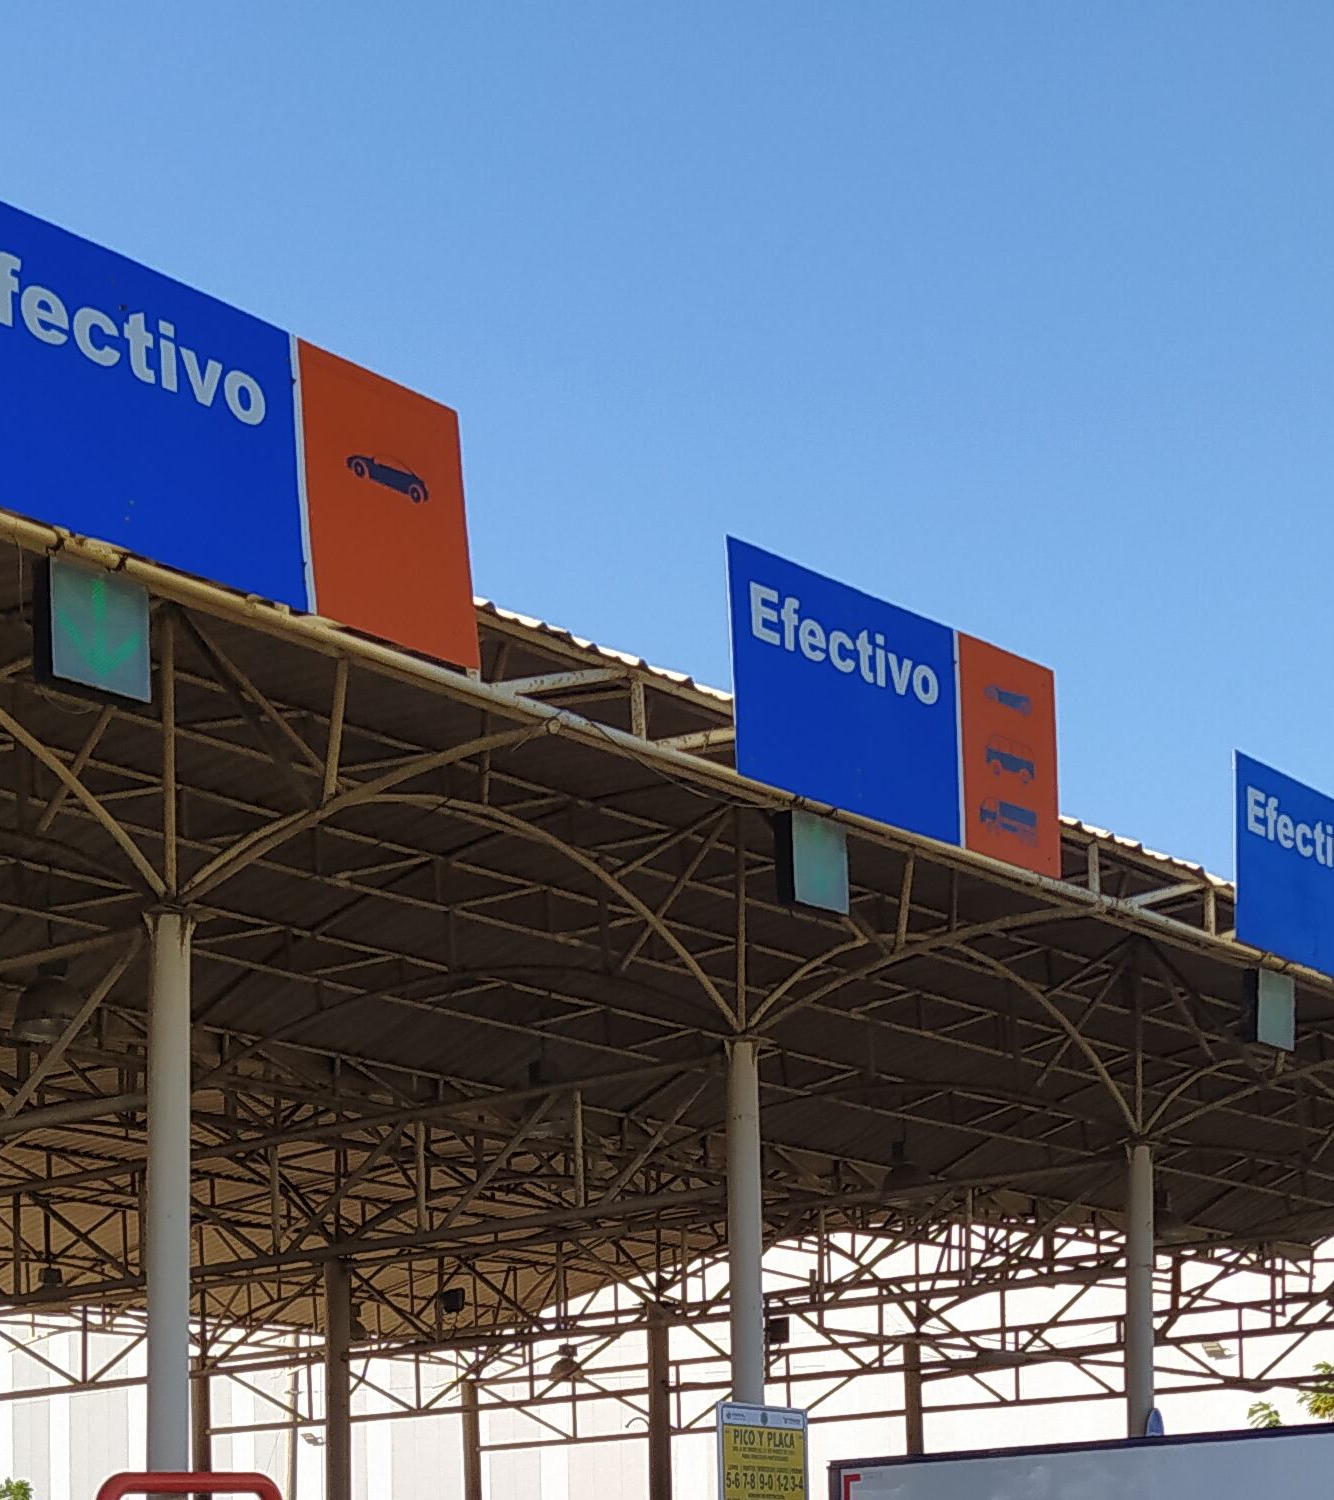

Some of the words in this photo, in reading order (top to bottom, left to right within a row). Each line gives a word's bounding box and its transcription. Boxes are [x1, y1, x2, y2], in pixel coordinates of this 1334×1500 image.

[748, 580, 939, 706] Efectivo
[733, 1429, 756, 1446] PICO
[758, 1430, 765, 1447] Y
[767, 1432, 795, 1449] PLACA
[726, 1472, 741, 1489] 5-6
[743, 1472, 756, 1490] 7-8
[759, 1473, 774, 1491] 9-0
